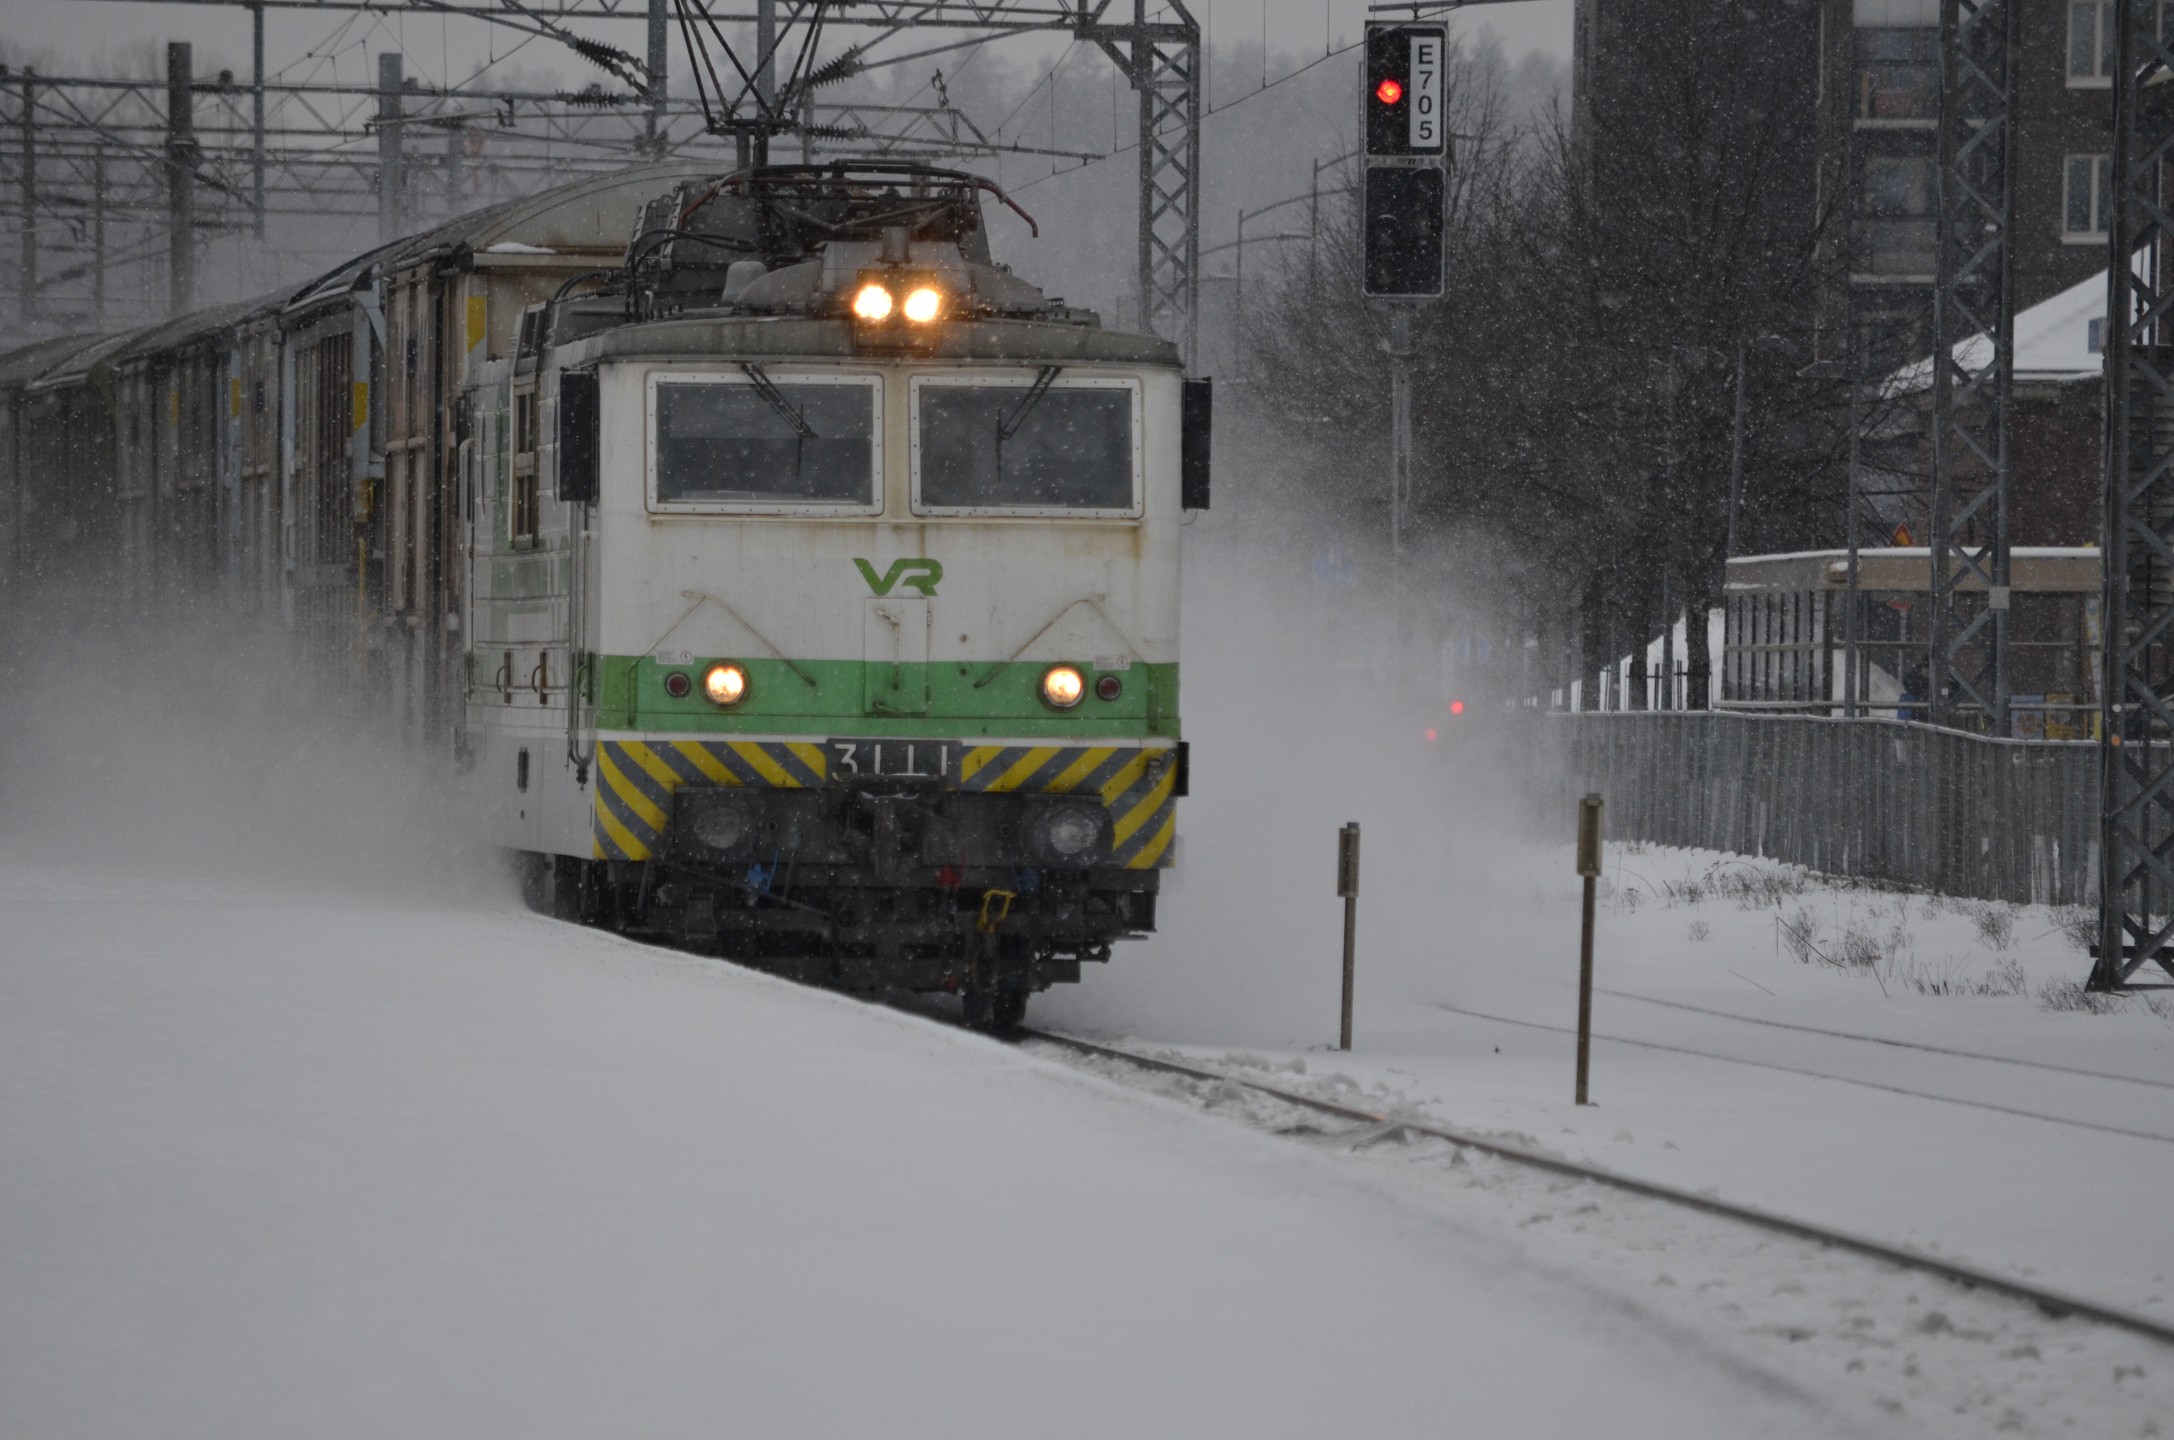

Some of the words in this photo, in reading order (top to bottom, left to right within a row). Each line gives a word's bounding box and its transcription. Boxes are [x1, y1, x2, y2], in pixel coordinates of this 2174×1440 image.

[1418, 44, 1433, 140] E705
[852, 558, 943, 596] VR
[832, 743, 948, 779] 3111
